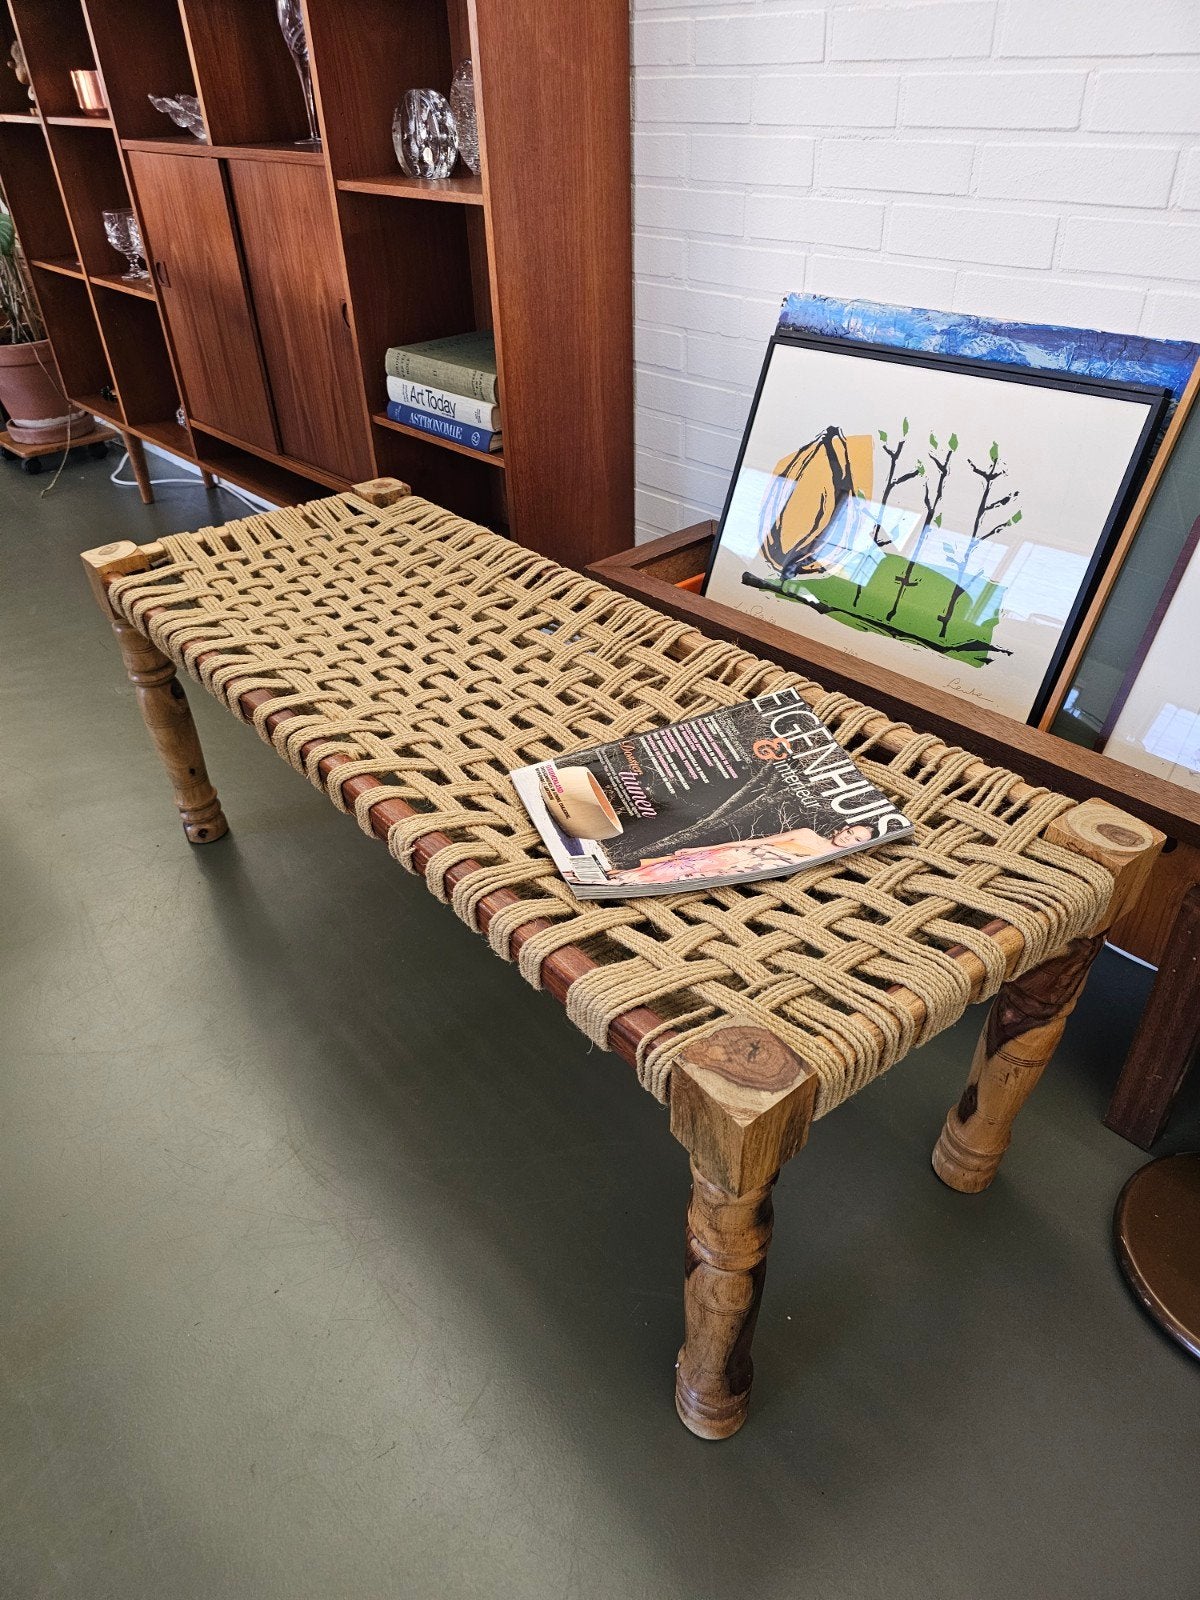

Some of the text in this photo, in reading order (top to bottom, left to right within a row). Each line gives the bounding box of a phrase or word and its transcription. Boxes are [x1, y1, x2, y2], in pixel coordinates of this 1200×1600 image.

[410, 385, 426, 407] Art
[425, 389, 457, 418] Today
[409, 412, 463, 440] ASTRONOMIE
[619, 740, 643, 775] Dossier
[753, 737, 822, 809] & interieur
[618, 770, 658, 819] tuinen
